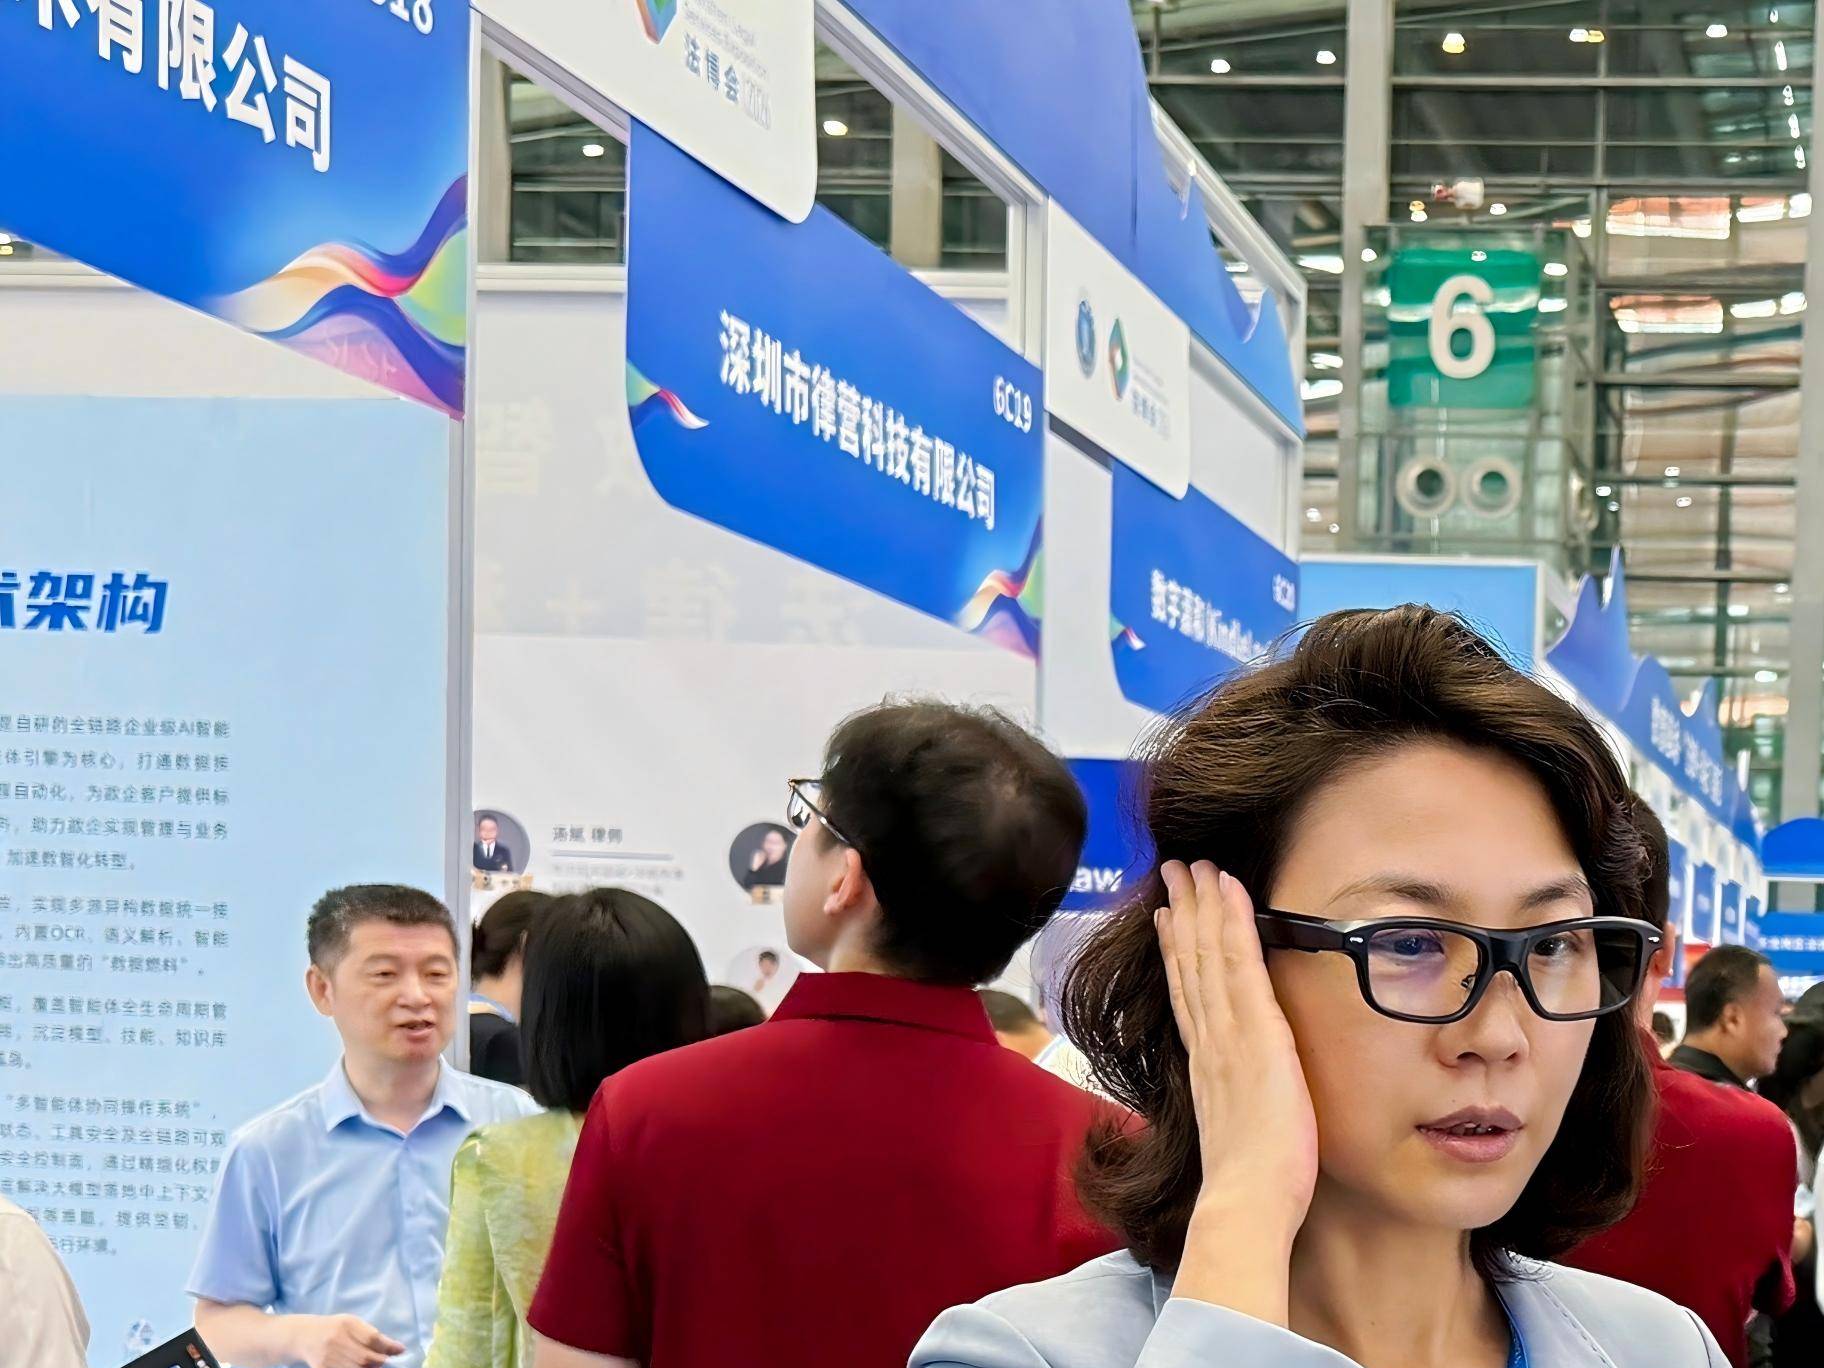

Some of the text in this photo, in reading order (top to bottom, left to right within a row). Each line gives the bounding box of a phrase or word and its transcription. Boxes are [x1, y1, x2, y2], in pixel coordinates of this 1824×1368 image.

[15, 0, 331, 172] 有限公司
[1429, 274, 1495, 379] 6
[719, 308, 995, 531] 深圳市律营科技有限公司
[993, 365, 1032, 433] 6C19
